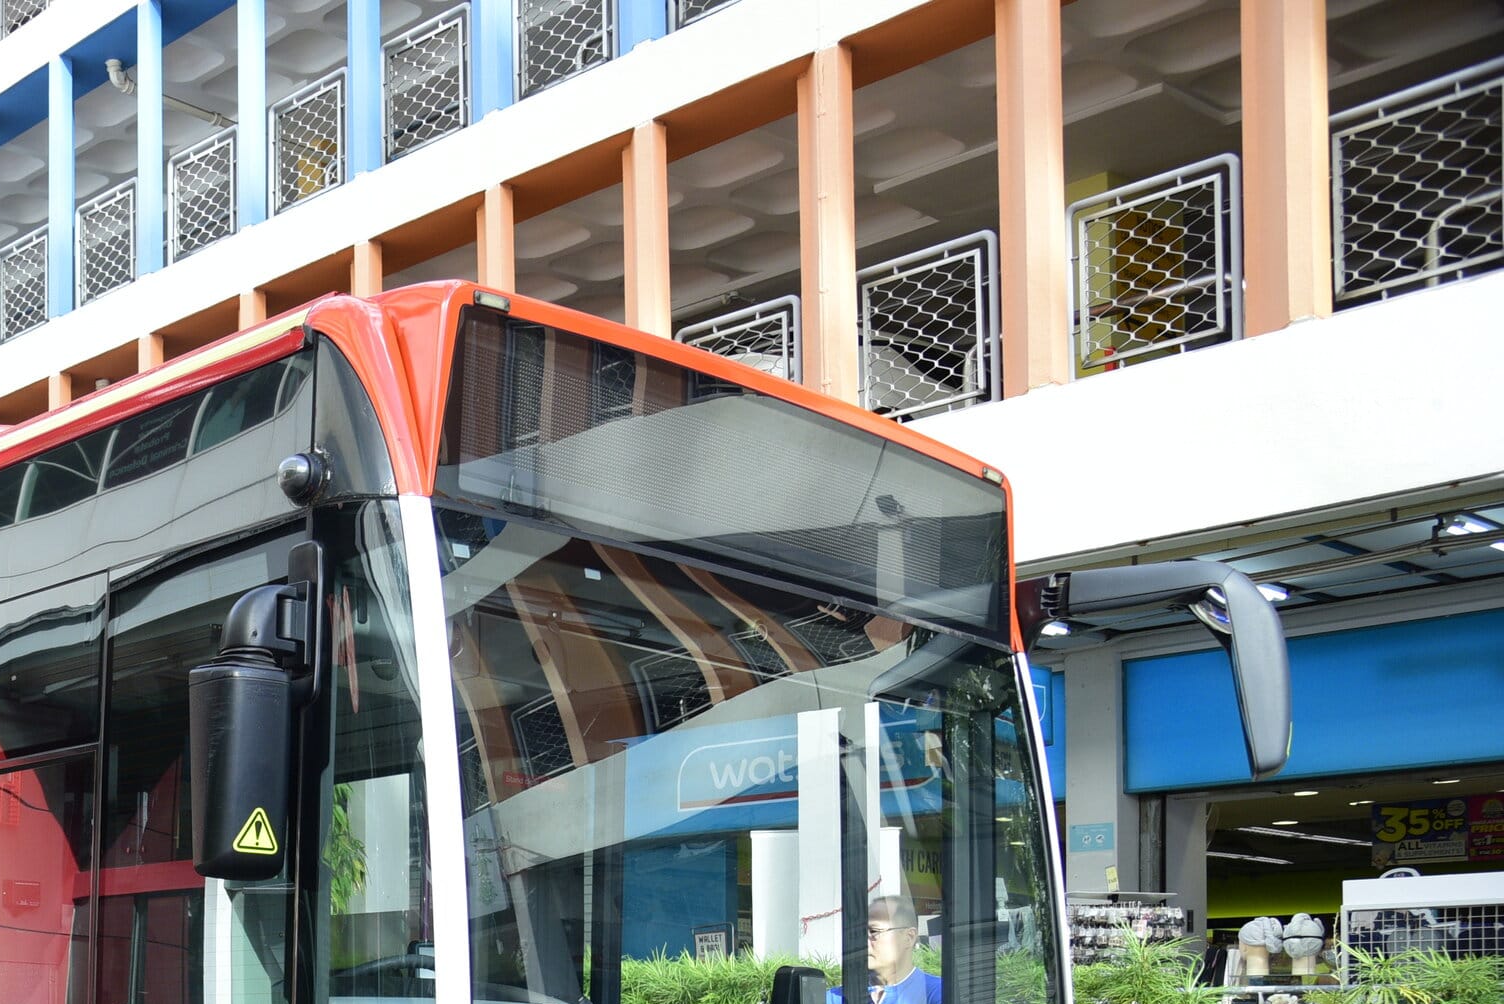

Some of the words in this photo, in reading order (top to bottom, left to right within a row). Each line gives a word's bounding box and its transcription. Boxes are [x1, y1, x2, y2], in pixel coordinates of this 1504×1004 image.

[1376, 807, 1431, 843] 35
[1432, 819, 1465, 831] OFF
[1398, 839, 1423, 851] ALL
